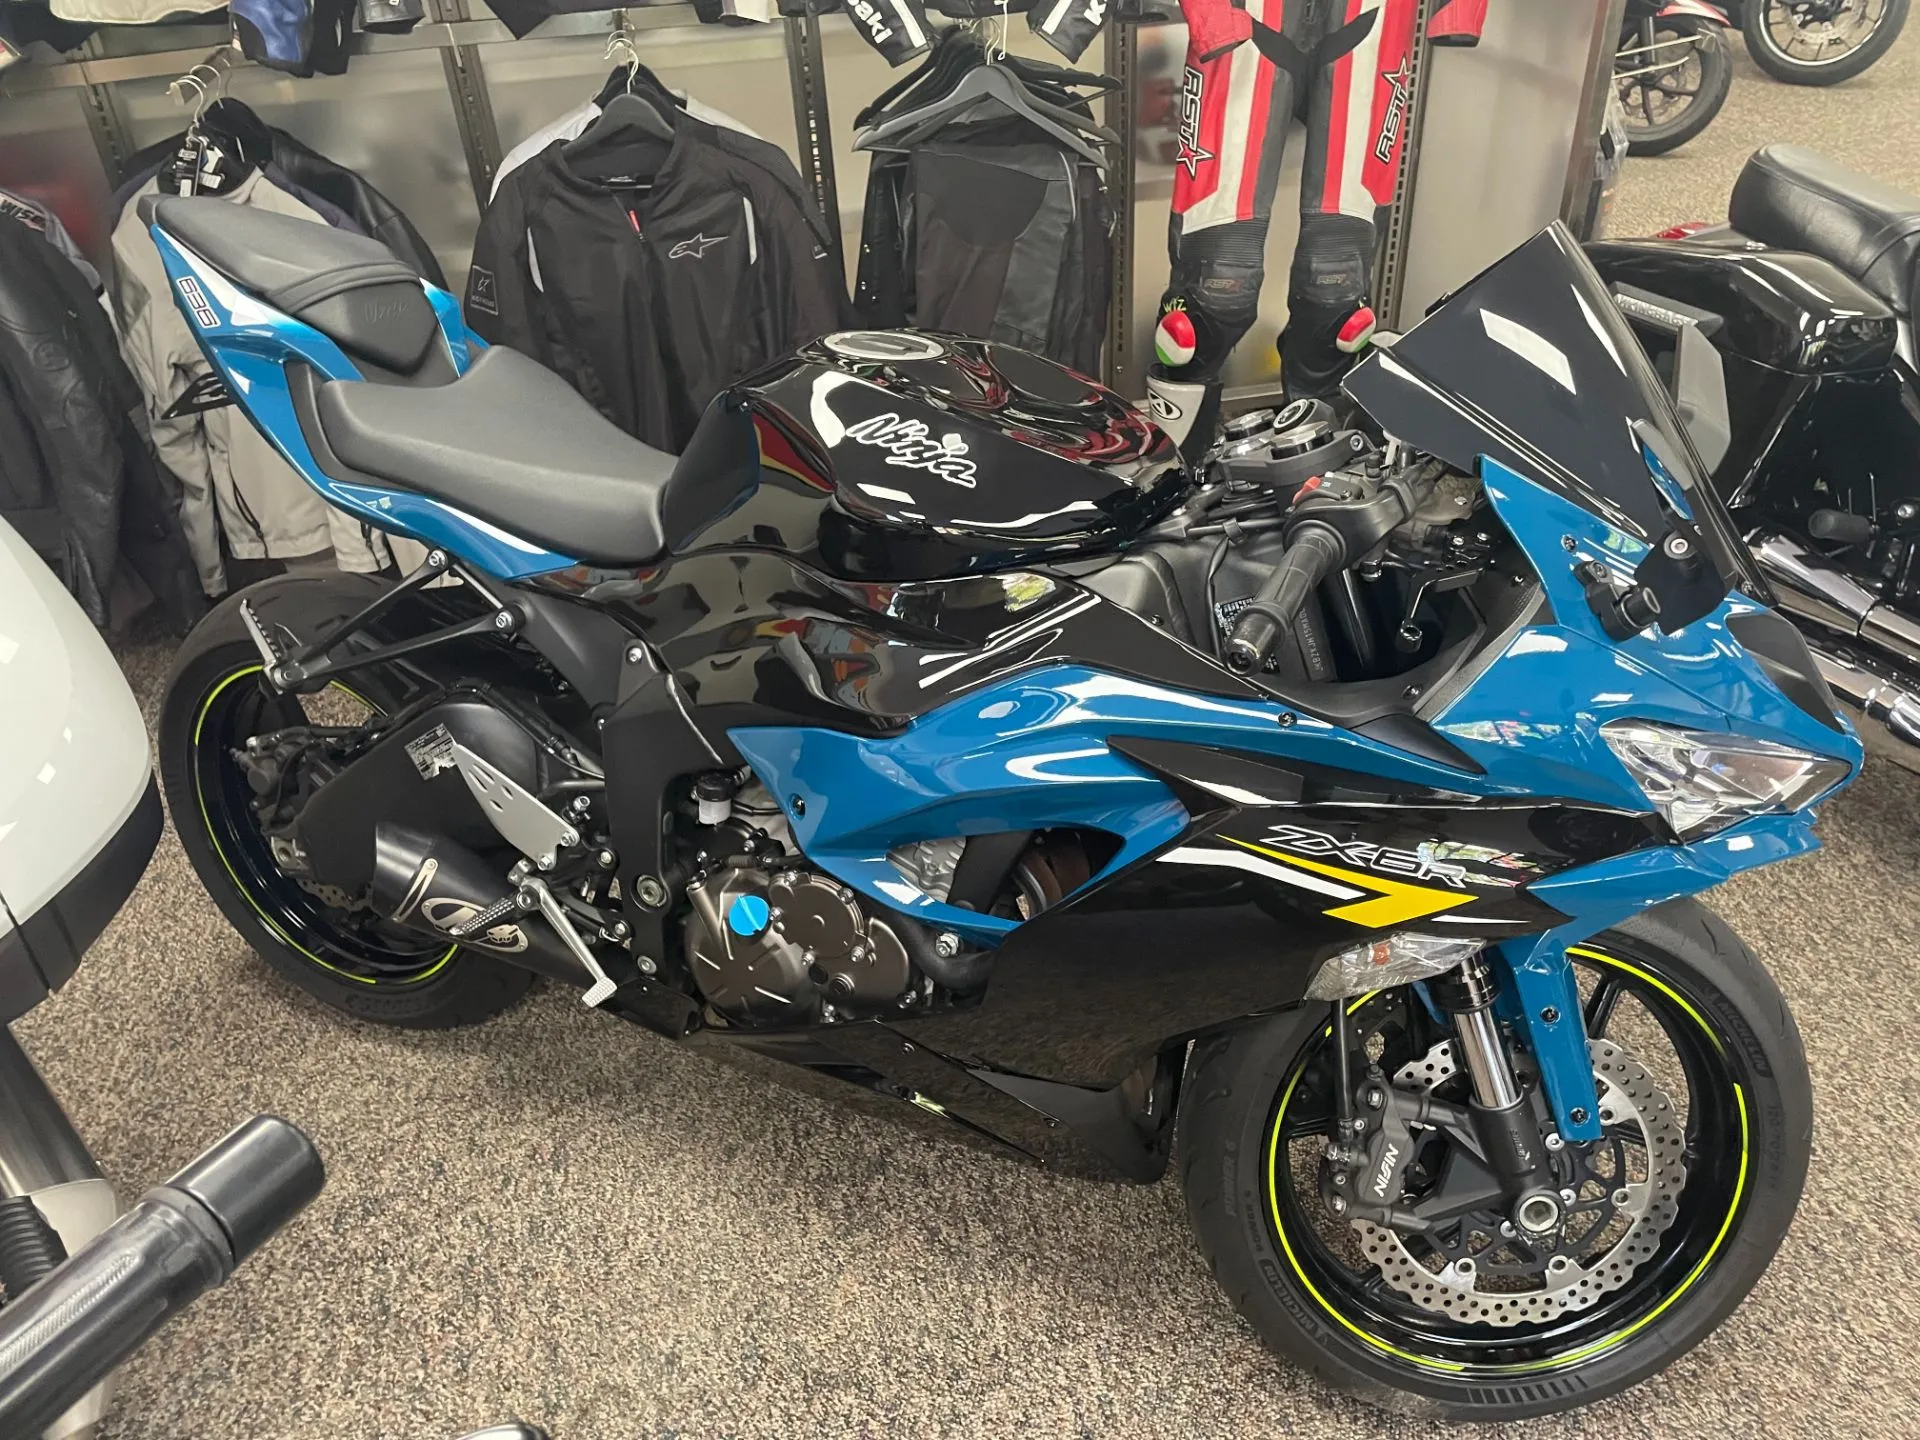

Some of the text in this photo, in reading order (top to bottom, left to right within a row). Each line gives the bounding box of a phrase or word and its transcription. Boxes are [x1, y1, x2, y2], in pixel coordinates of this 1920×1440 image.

[1181, 65, 1203, 151] RST
[176, 275, 221, 329] 636
[845, 412, 978, 489] Ninja
[1258, 824, 1467, 889] ZX-6R
[1262, 1263, 1318, 1332] MICHELIN
